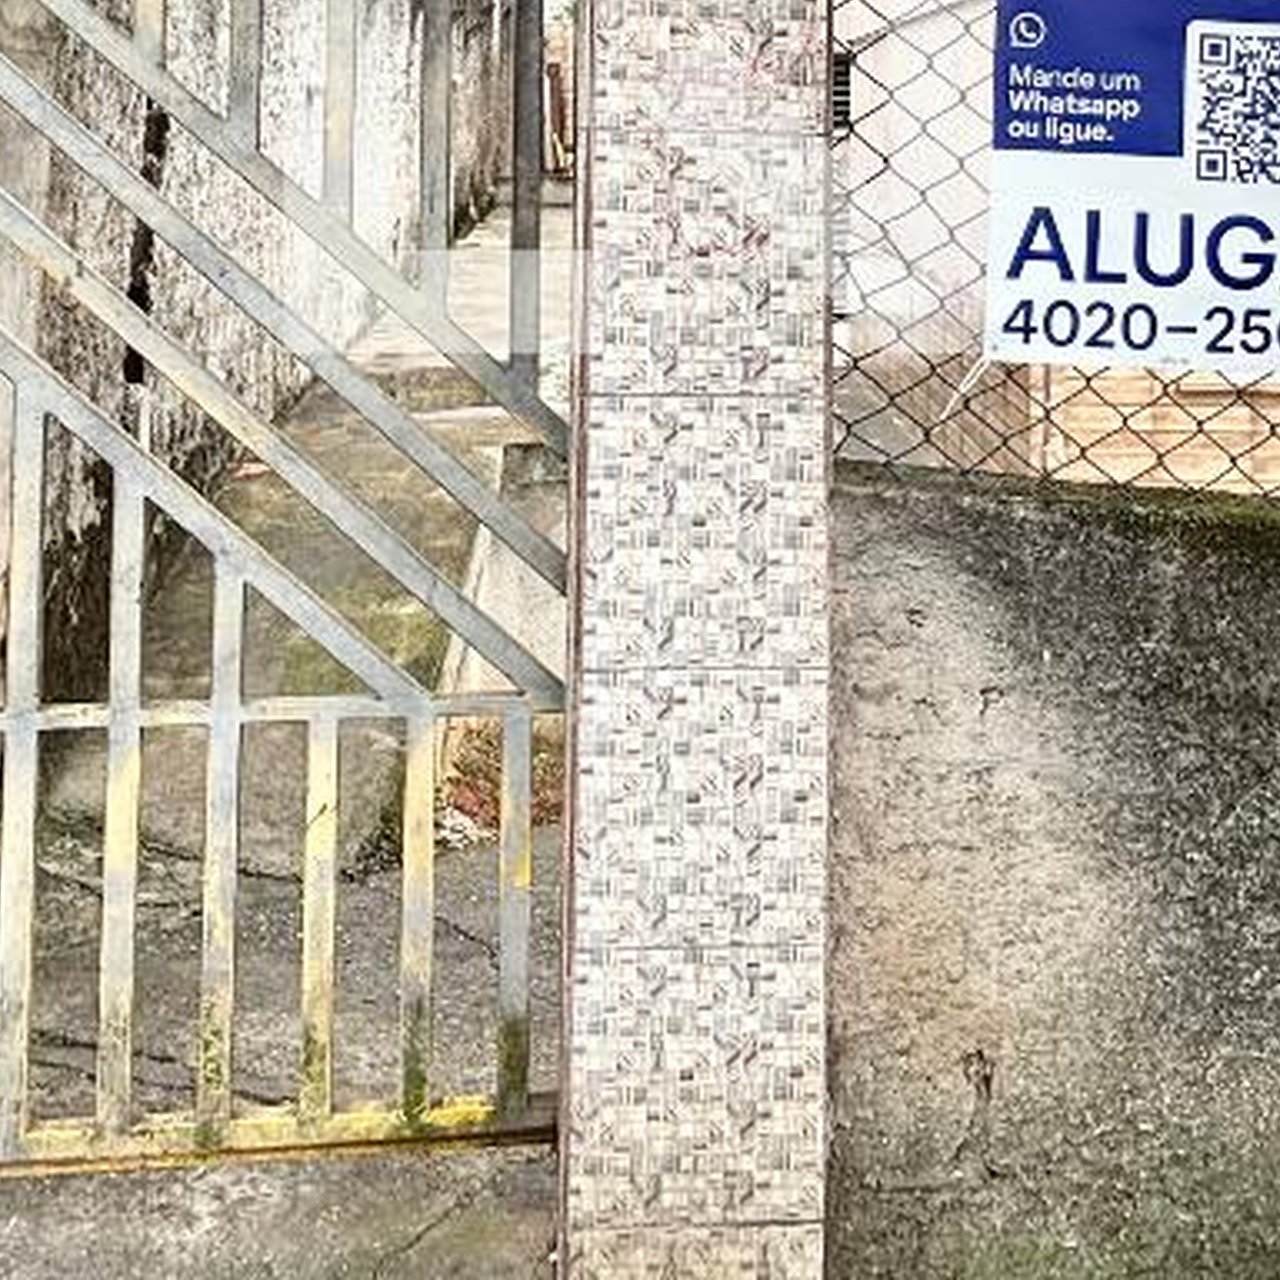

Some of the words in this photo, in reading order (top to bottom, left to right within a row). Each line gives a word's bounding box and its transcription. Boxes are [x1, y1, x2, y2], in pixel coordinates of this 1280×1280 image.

[1008, 64, 1095, 90] Mande
[1100, 72, 1141, 91] um
[1007, 90, 1141, 121] Whatsapp
[1008, 119, 1039, 140] ou
[1044, 116, 1114, 144] ligue.
